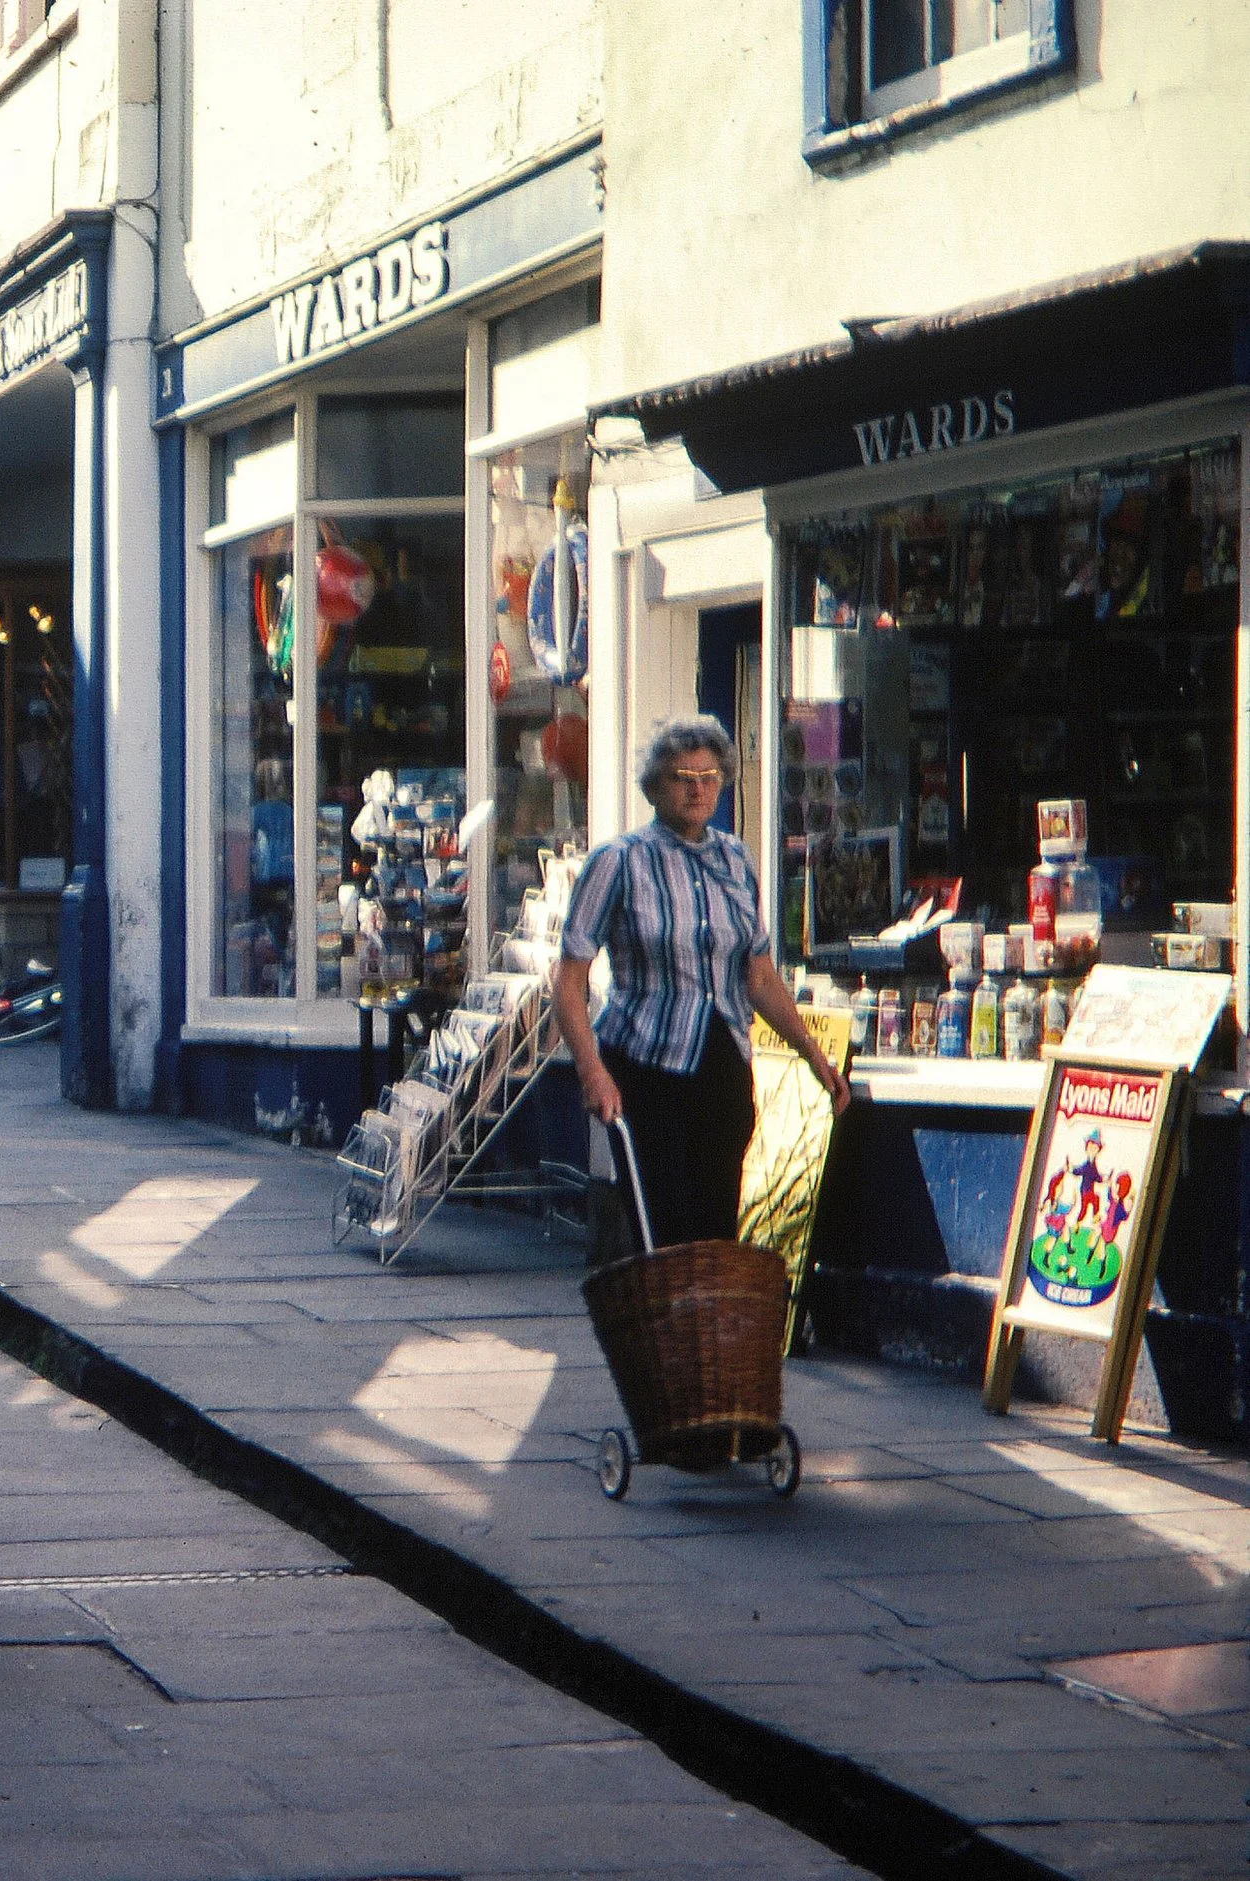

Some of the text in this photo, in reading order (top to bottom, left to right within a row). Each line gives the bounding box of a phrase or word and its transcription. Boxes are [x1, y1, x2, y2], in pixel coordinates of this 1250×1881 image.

[270, 221, 449, 364] WARDS
[853, 389, 1015, 466] WARDS
[1060, 1076, 1156, 1120] Lyons Maid
